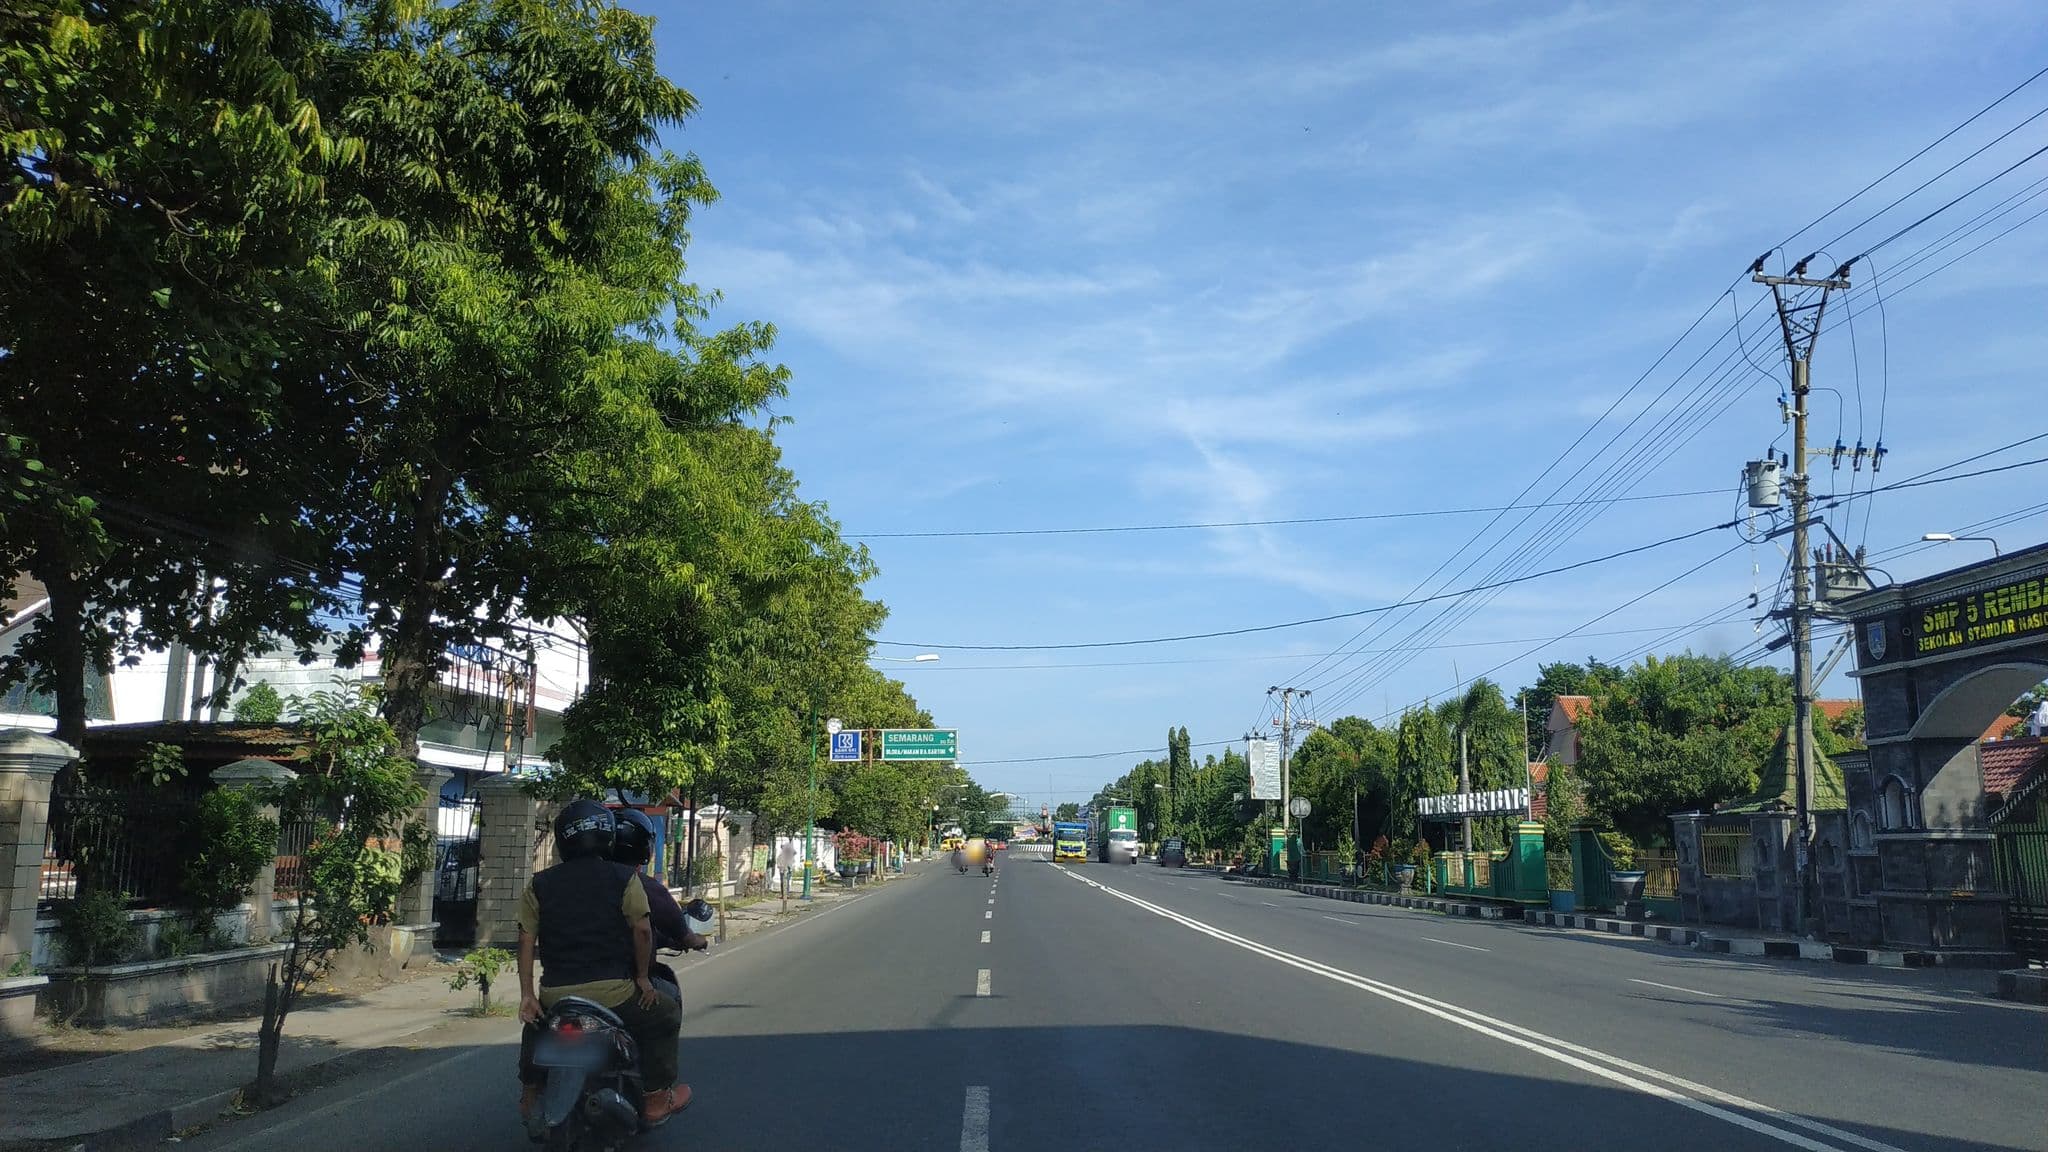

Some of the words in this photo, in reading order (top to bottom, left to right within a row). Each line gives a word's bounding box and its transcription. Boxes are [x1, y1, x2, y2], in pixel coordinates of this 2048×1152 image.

[1923, 602, 1960, 633] SMP
[1967, 596, 1979, 623] 5
[1919, 631, 1963, 651] SEKOLAH
[1967, 619, 2016, 641] STANDAR
[888, 734, 934, 742] SEMARANG
